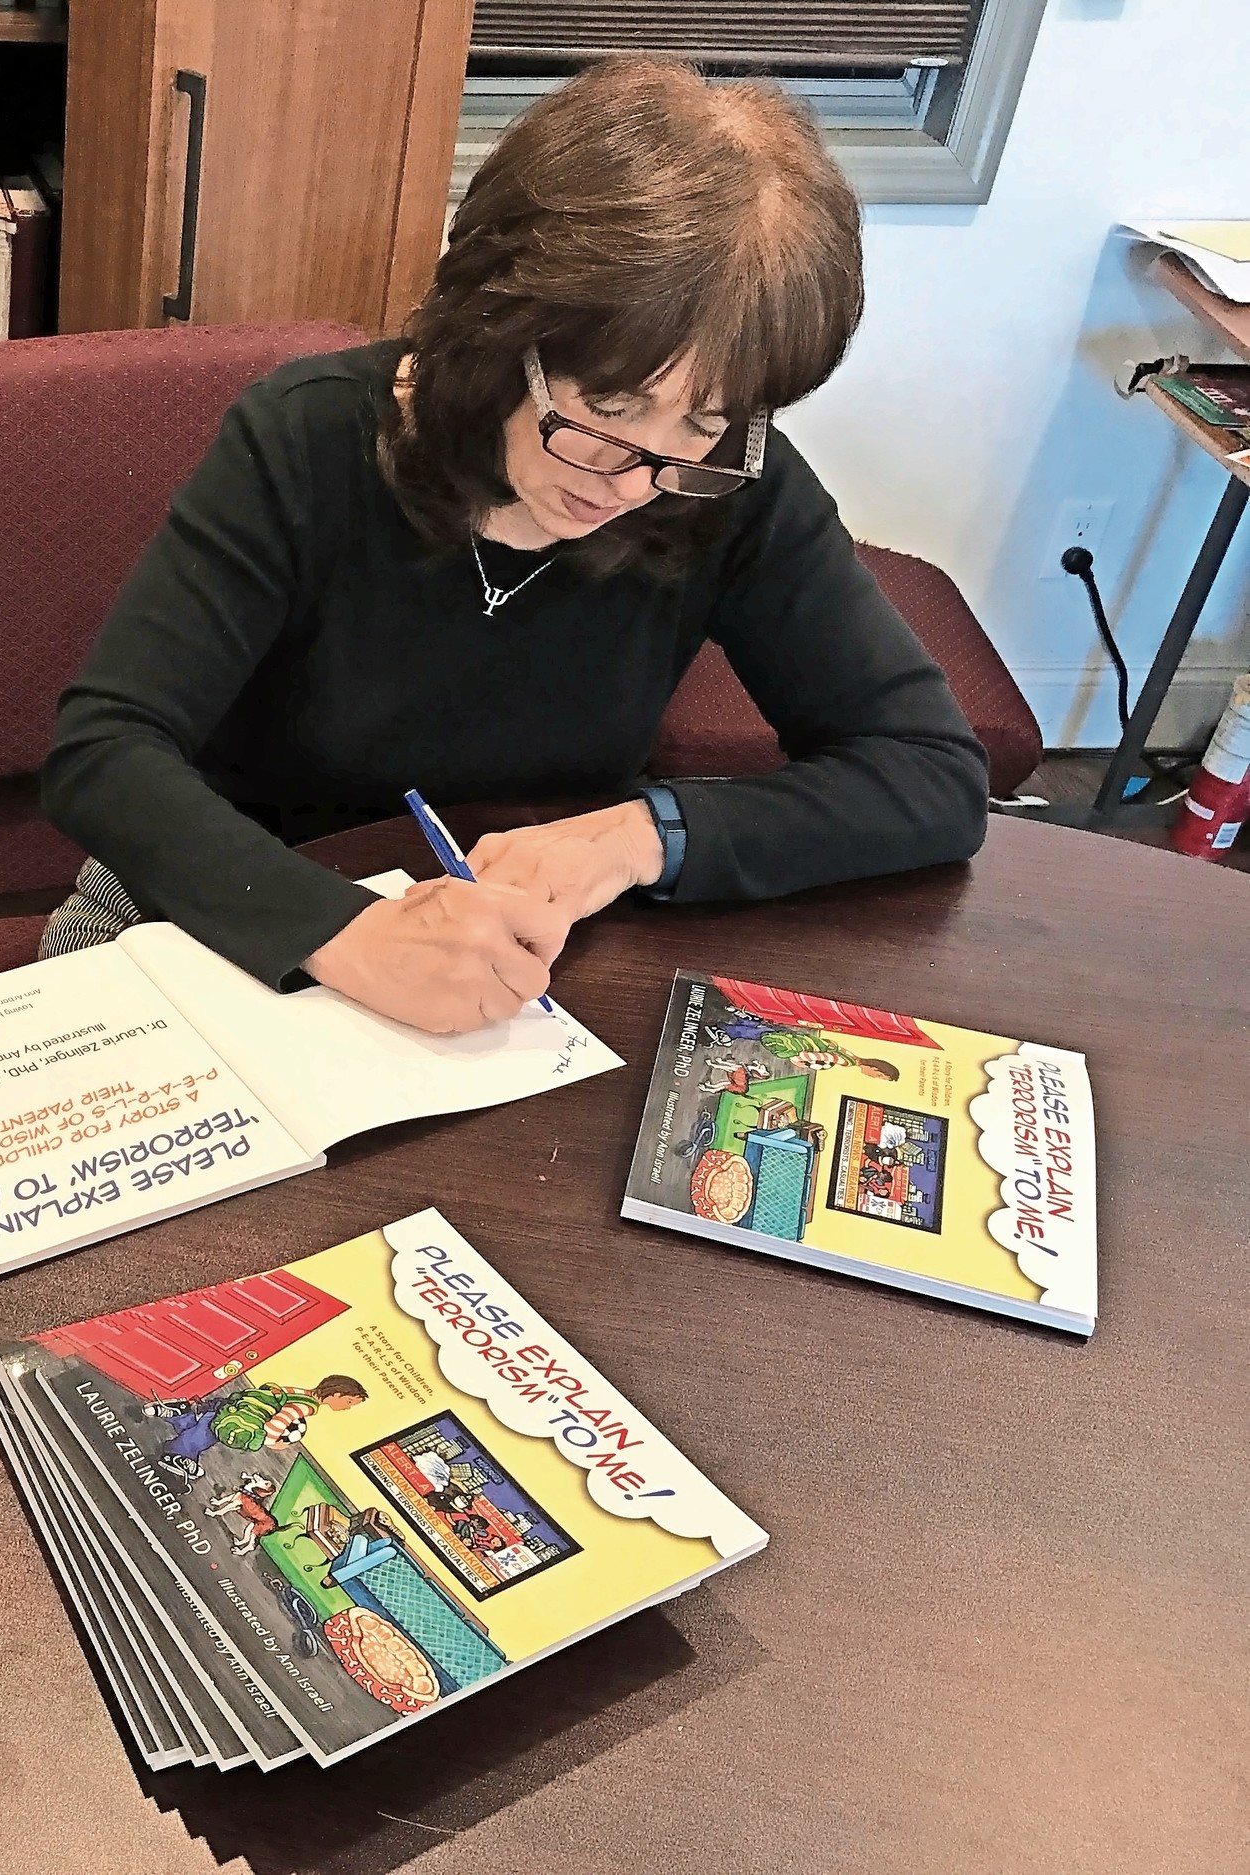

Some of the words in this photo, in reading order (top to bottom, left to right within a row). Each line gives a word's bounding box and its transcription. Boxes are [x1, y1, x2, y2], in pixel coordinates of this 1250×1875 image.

[0, 994, 23, 1005] Arbor
[24, 988, 41, 998] Ann
[688, 984, 706, 1008] LAURIE
[3, 1003, 33, 1015] Loving
[42, 1022, 107, 1049] Illustrated
[101, 1026, 147, 1046] Laurie
[146, 1019, 168, 1030] Dr.
[676, 1006, 702, 1052] ZELINGER,
[24, 1044, 42, 1054] by
[39, 1041, 101, 1065] Zelinger,
[3, 1062, 39, 1078] PhD,
[673, 1054, 692, 1077] PhD
[81, 1081, 135, 1105] THEIR
[92, 1067, 219, 1119] P-E-A-R-L-S
[185, 1089, 199, 1102] A
[1036, 1060, 1070, 1124] PLEASE
[57, 1112, 84, 1131] OF
[119, 1097, 181, 1128] STORY
[662, 1091, 680, 1131] Illustrated
[70, 1120, 112, 1143] FOR
[657, 1130, 671, 1141] by
[130, 1134, 251, 1191] PLEASE
[655, 1141, 669, 1158] Ann
[650, 1158, 665, 1184] Israeli
[1014, 1168, 1042, 1200] TO
[1044, 1127, 1075, 1222] EXPLAIN
[13, 1173, 58, 1201] TO
[1013, 1200, 1059, 1257] ME!
[415, 1245, 524, 1340] PLEASE
[516, 1344, 644, 1450] EXPLAIN
[352, 1342, 364, 1353] for
[362, 1353, 380, 1372] their
[379, 1371, 405, 1400] Parents
[355, 1326, 393, 1367] P-E-A-R-L-S
[390, 1367, 402, 1375] of
[399, 1375, 426, 1405] Wisdom
[375, 1331, 395, 1351] Story
[393, 1351, 405, 1362] for
[404, 1362, 434, 1396] Children,
[75, 1381, 126, 1439] LAURIE
[115, 1437, 182, 1521] ZELINGER,
[175, 1519, 212, 1555] PhD
[549, 1409, 598, 1448] TO
[585, 1452, 676, 1501] ME!
[371, 1451, 417, 1498] BREAKING
[217, 1578, 270, 1638] Illustrated
[263, 1637, 281, 1652] by
[276, 1654, 301, 1677] Ann
[297, 1677, 334, 1712] Israeli
[226, 1654, 249, 1681] Ann
[245, 1680, 279, 1718] Israeli
